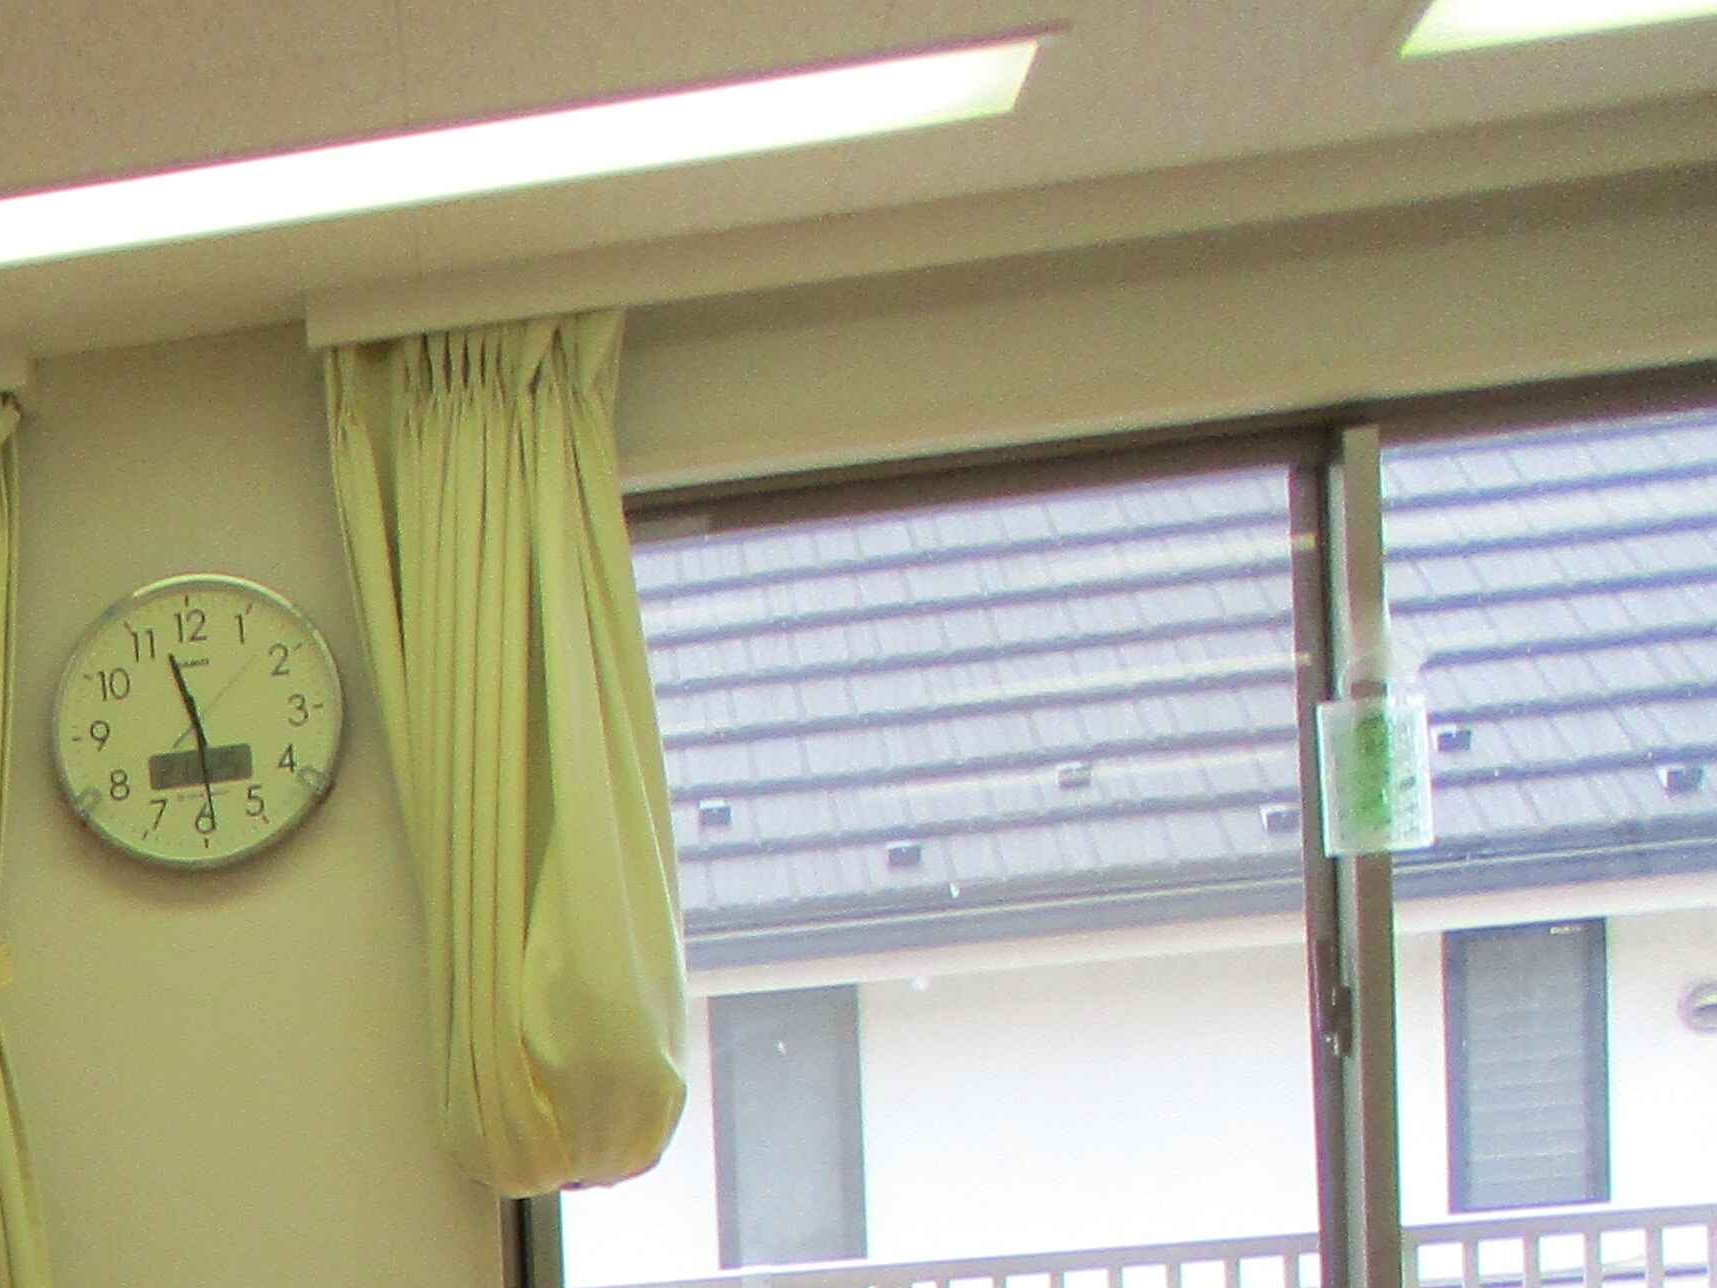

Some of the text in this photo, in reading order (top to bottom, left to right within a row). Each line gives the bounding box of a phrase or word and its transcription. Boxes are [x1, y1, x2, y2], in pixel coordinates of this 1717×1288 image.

[173, 608, 208, 643] 12
[234, 612, 246, 645] 1
[130, 628, 156, 663] 11
[268, 642, 291, 676] 2
[98, 667, 131, 701] 10
[287, 693, 310, 727] 3
[89, 719, 111, 752] 9
[277, 743, 297, 774] 4
[109, 768, 131, 801] 8
[245, 784, 265, 818] 5
[150, 798, 168, 831] 7
[194, 801, 215, 835] 6
